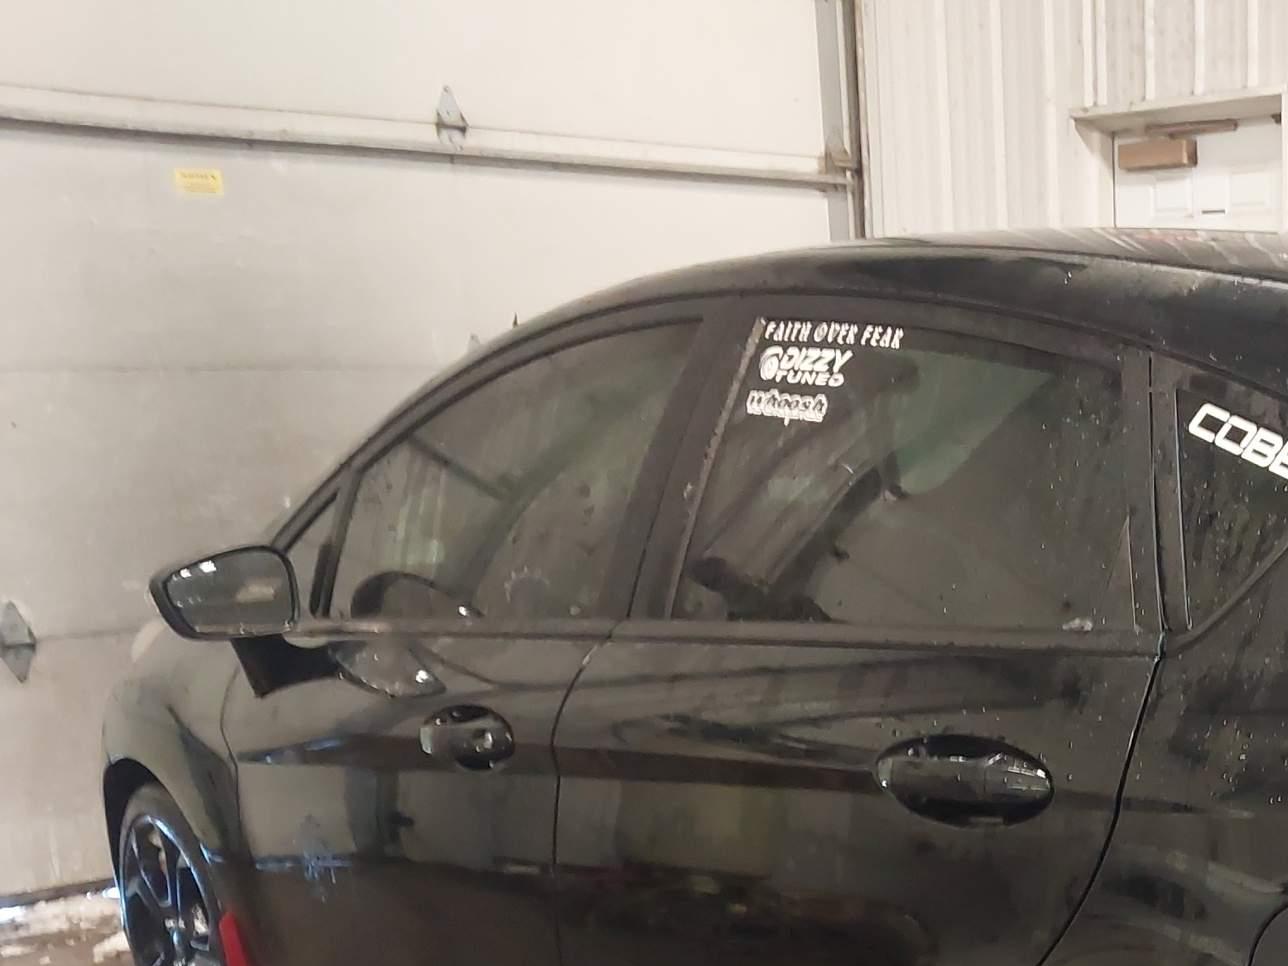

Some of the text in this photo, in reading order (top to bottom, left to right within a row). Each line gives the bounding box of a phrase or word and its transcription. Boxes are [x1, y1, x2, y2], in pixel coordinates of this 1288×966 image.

[765, 320, 904, 349] FAITH OVER FEAR
[779, 346, 853, 373] DIZZY
[775, 370, 844, 387] TUNED
